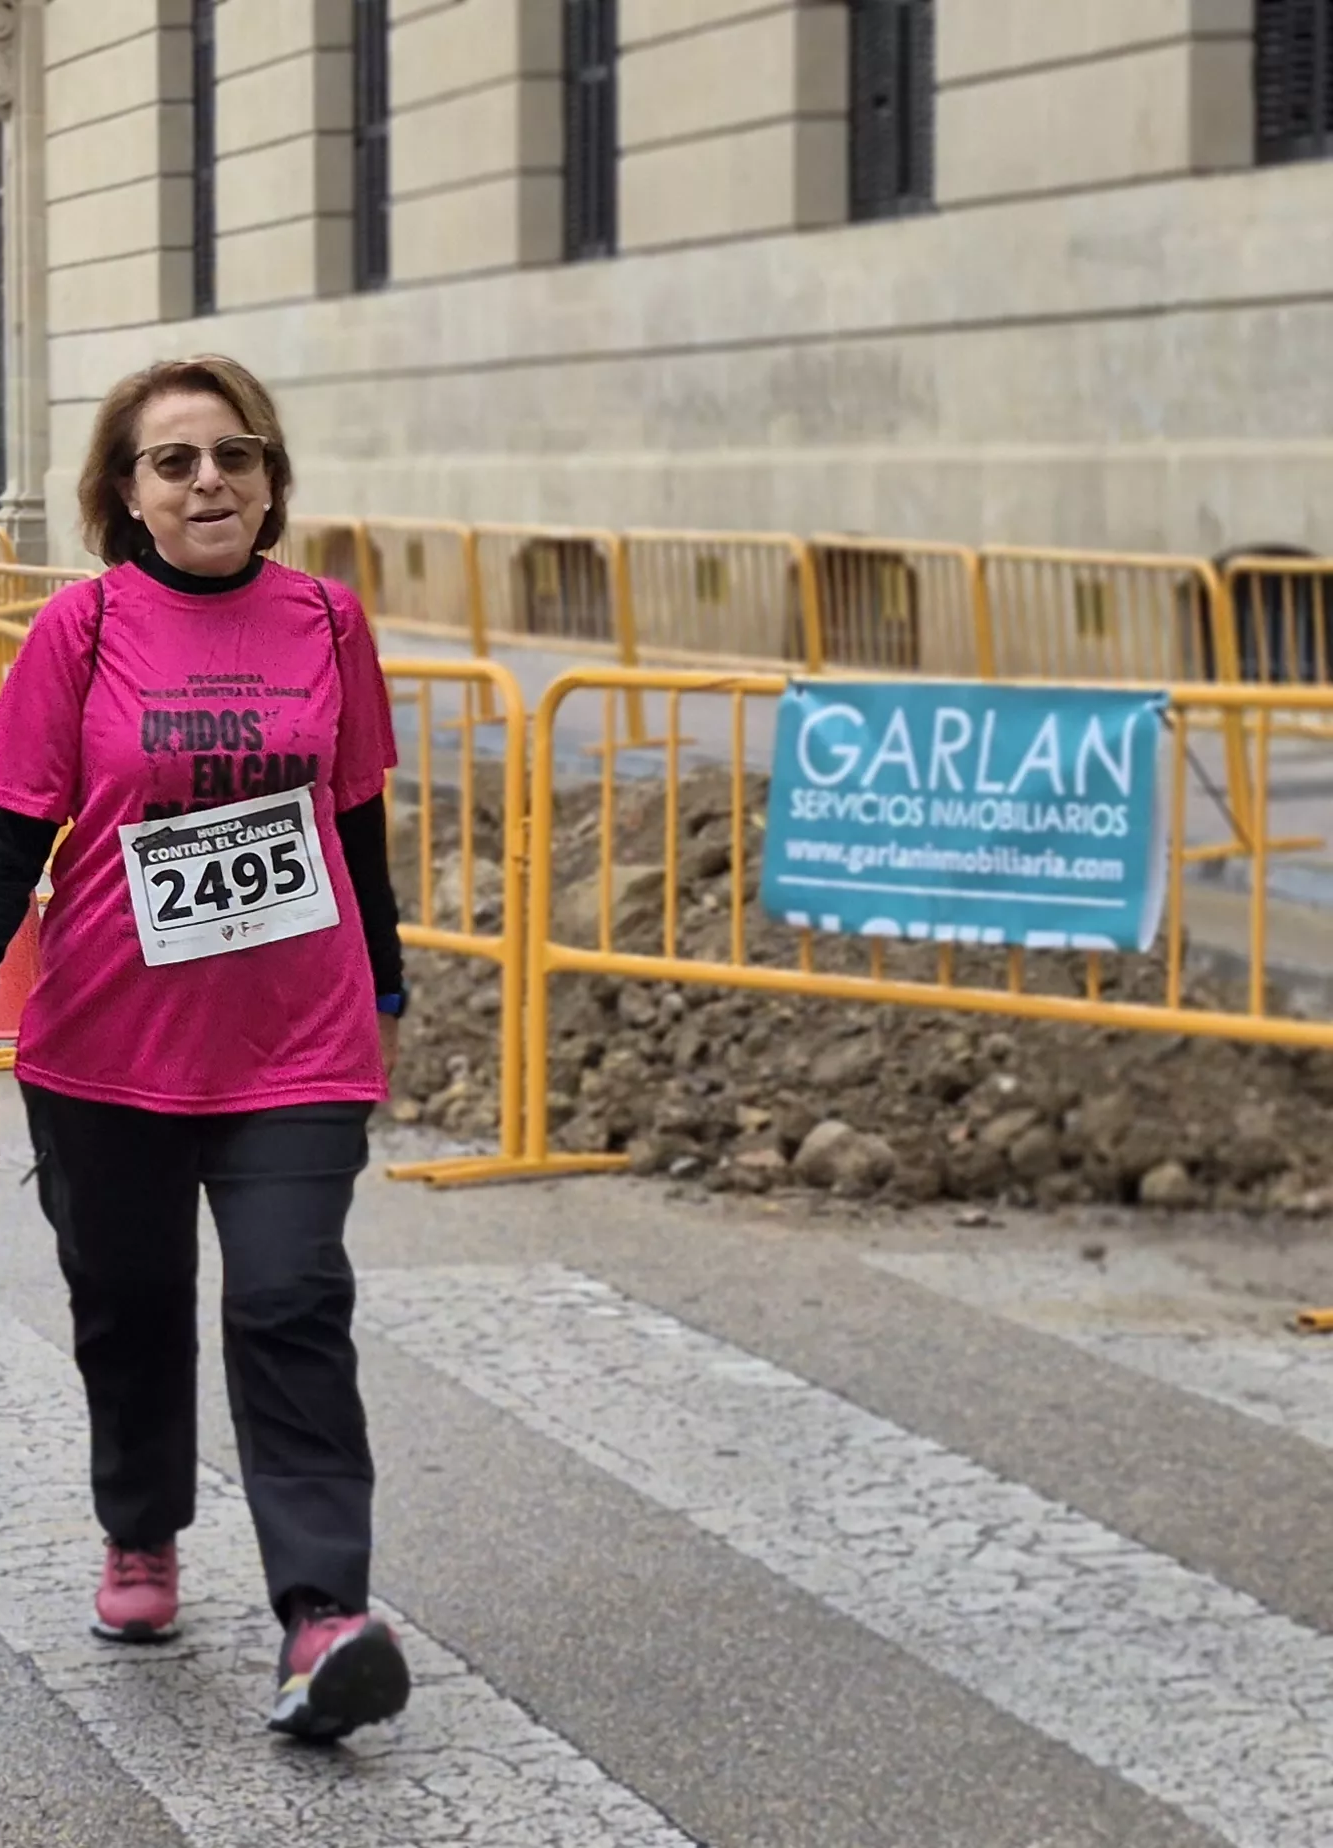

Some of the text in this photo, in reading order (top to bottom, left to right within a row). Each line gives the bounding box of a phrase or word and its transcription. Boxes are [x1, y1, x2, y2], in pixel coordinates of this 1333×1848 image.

[142, 709, 263, 753] UNIDOS
[797, 704, 1135, 797] GARLAN
[193, 754, 233, 798] EN
[197, 820, 243, 839] HUESCA
[790, 788, 1128, 836] SERVICIOS INMOBILIARIOS
[147, 819, 297, 862] CONTRA EL CÁNCER
[785, 839, 1123, 881] www.garlaninmobiliaria.com
[151, 840, 306, 922] 2495
